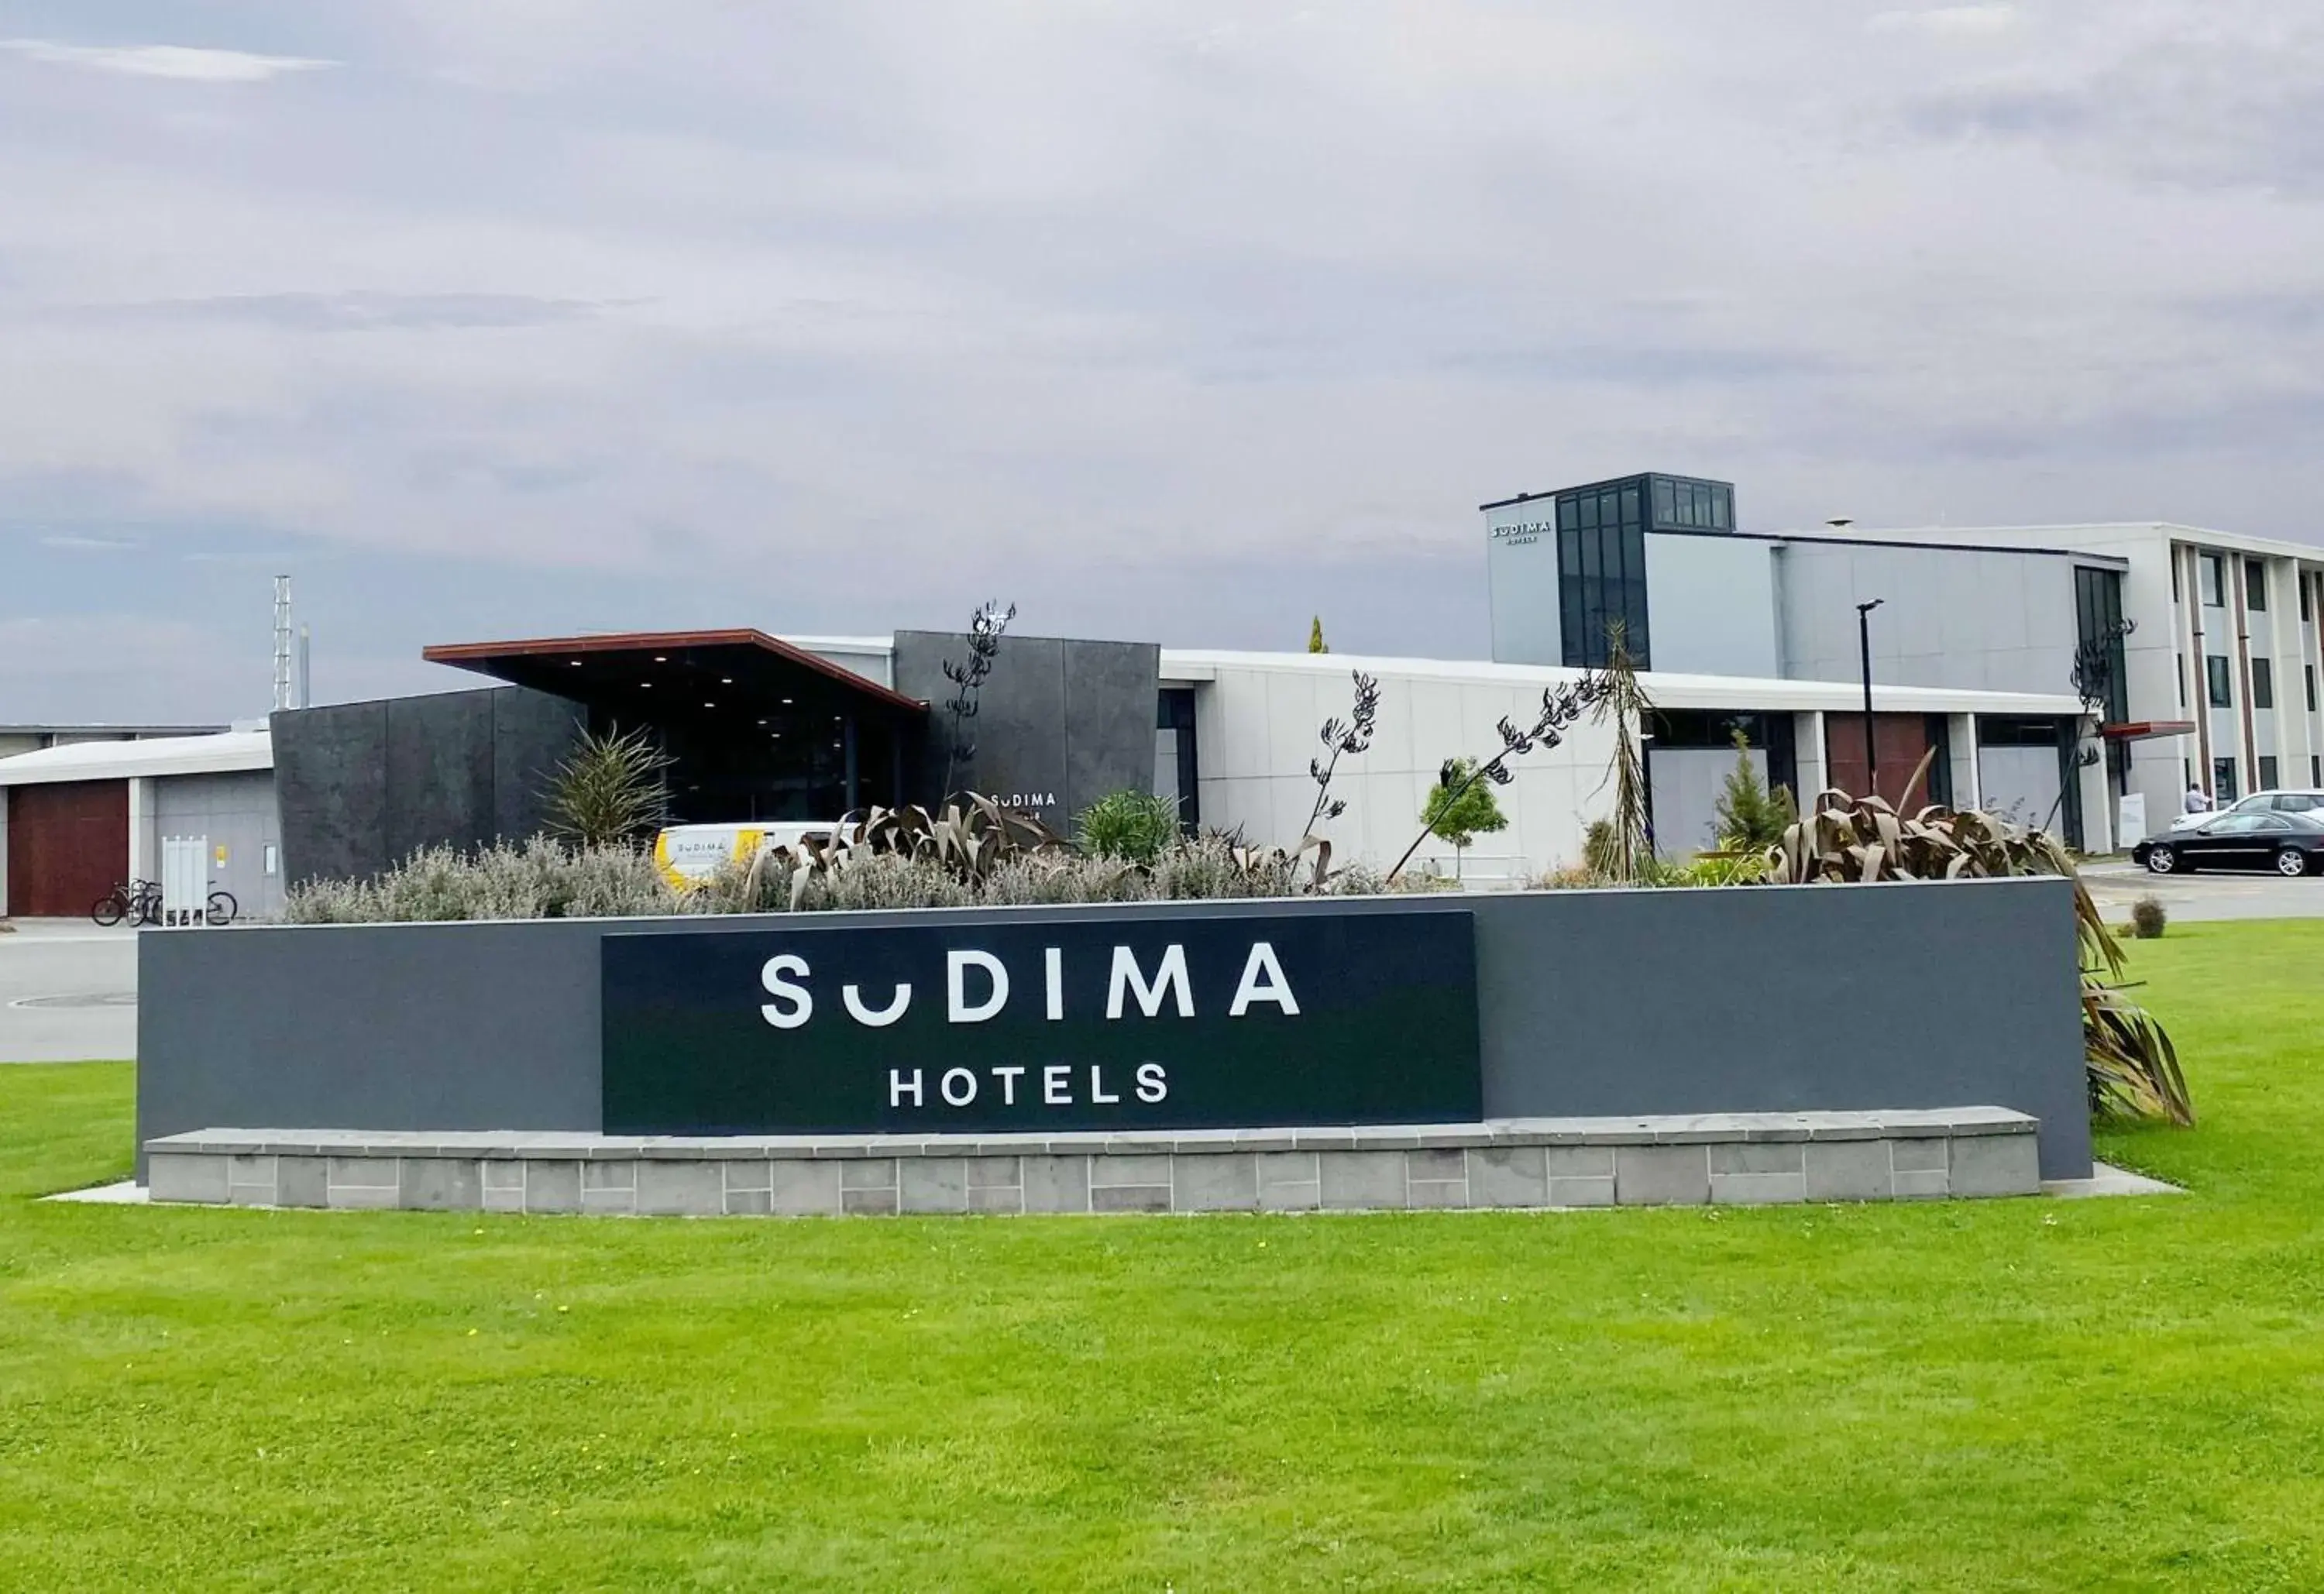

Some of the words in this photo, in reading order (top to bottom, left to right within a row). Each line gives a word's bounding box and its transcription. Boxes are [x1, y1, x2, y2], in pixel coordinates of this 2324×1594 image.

[991, 792, 1055, 807] SUDIMA
[761, 943, 1301, 1029] SUDIMA
[890, 1063, 1167, 1107] HOTELS
